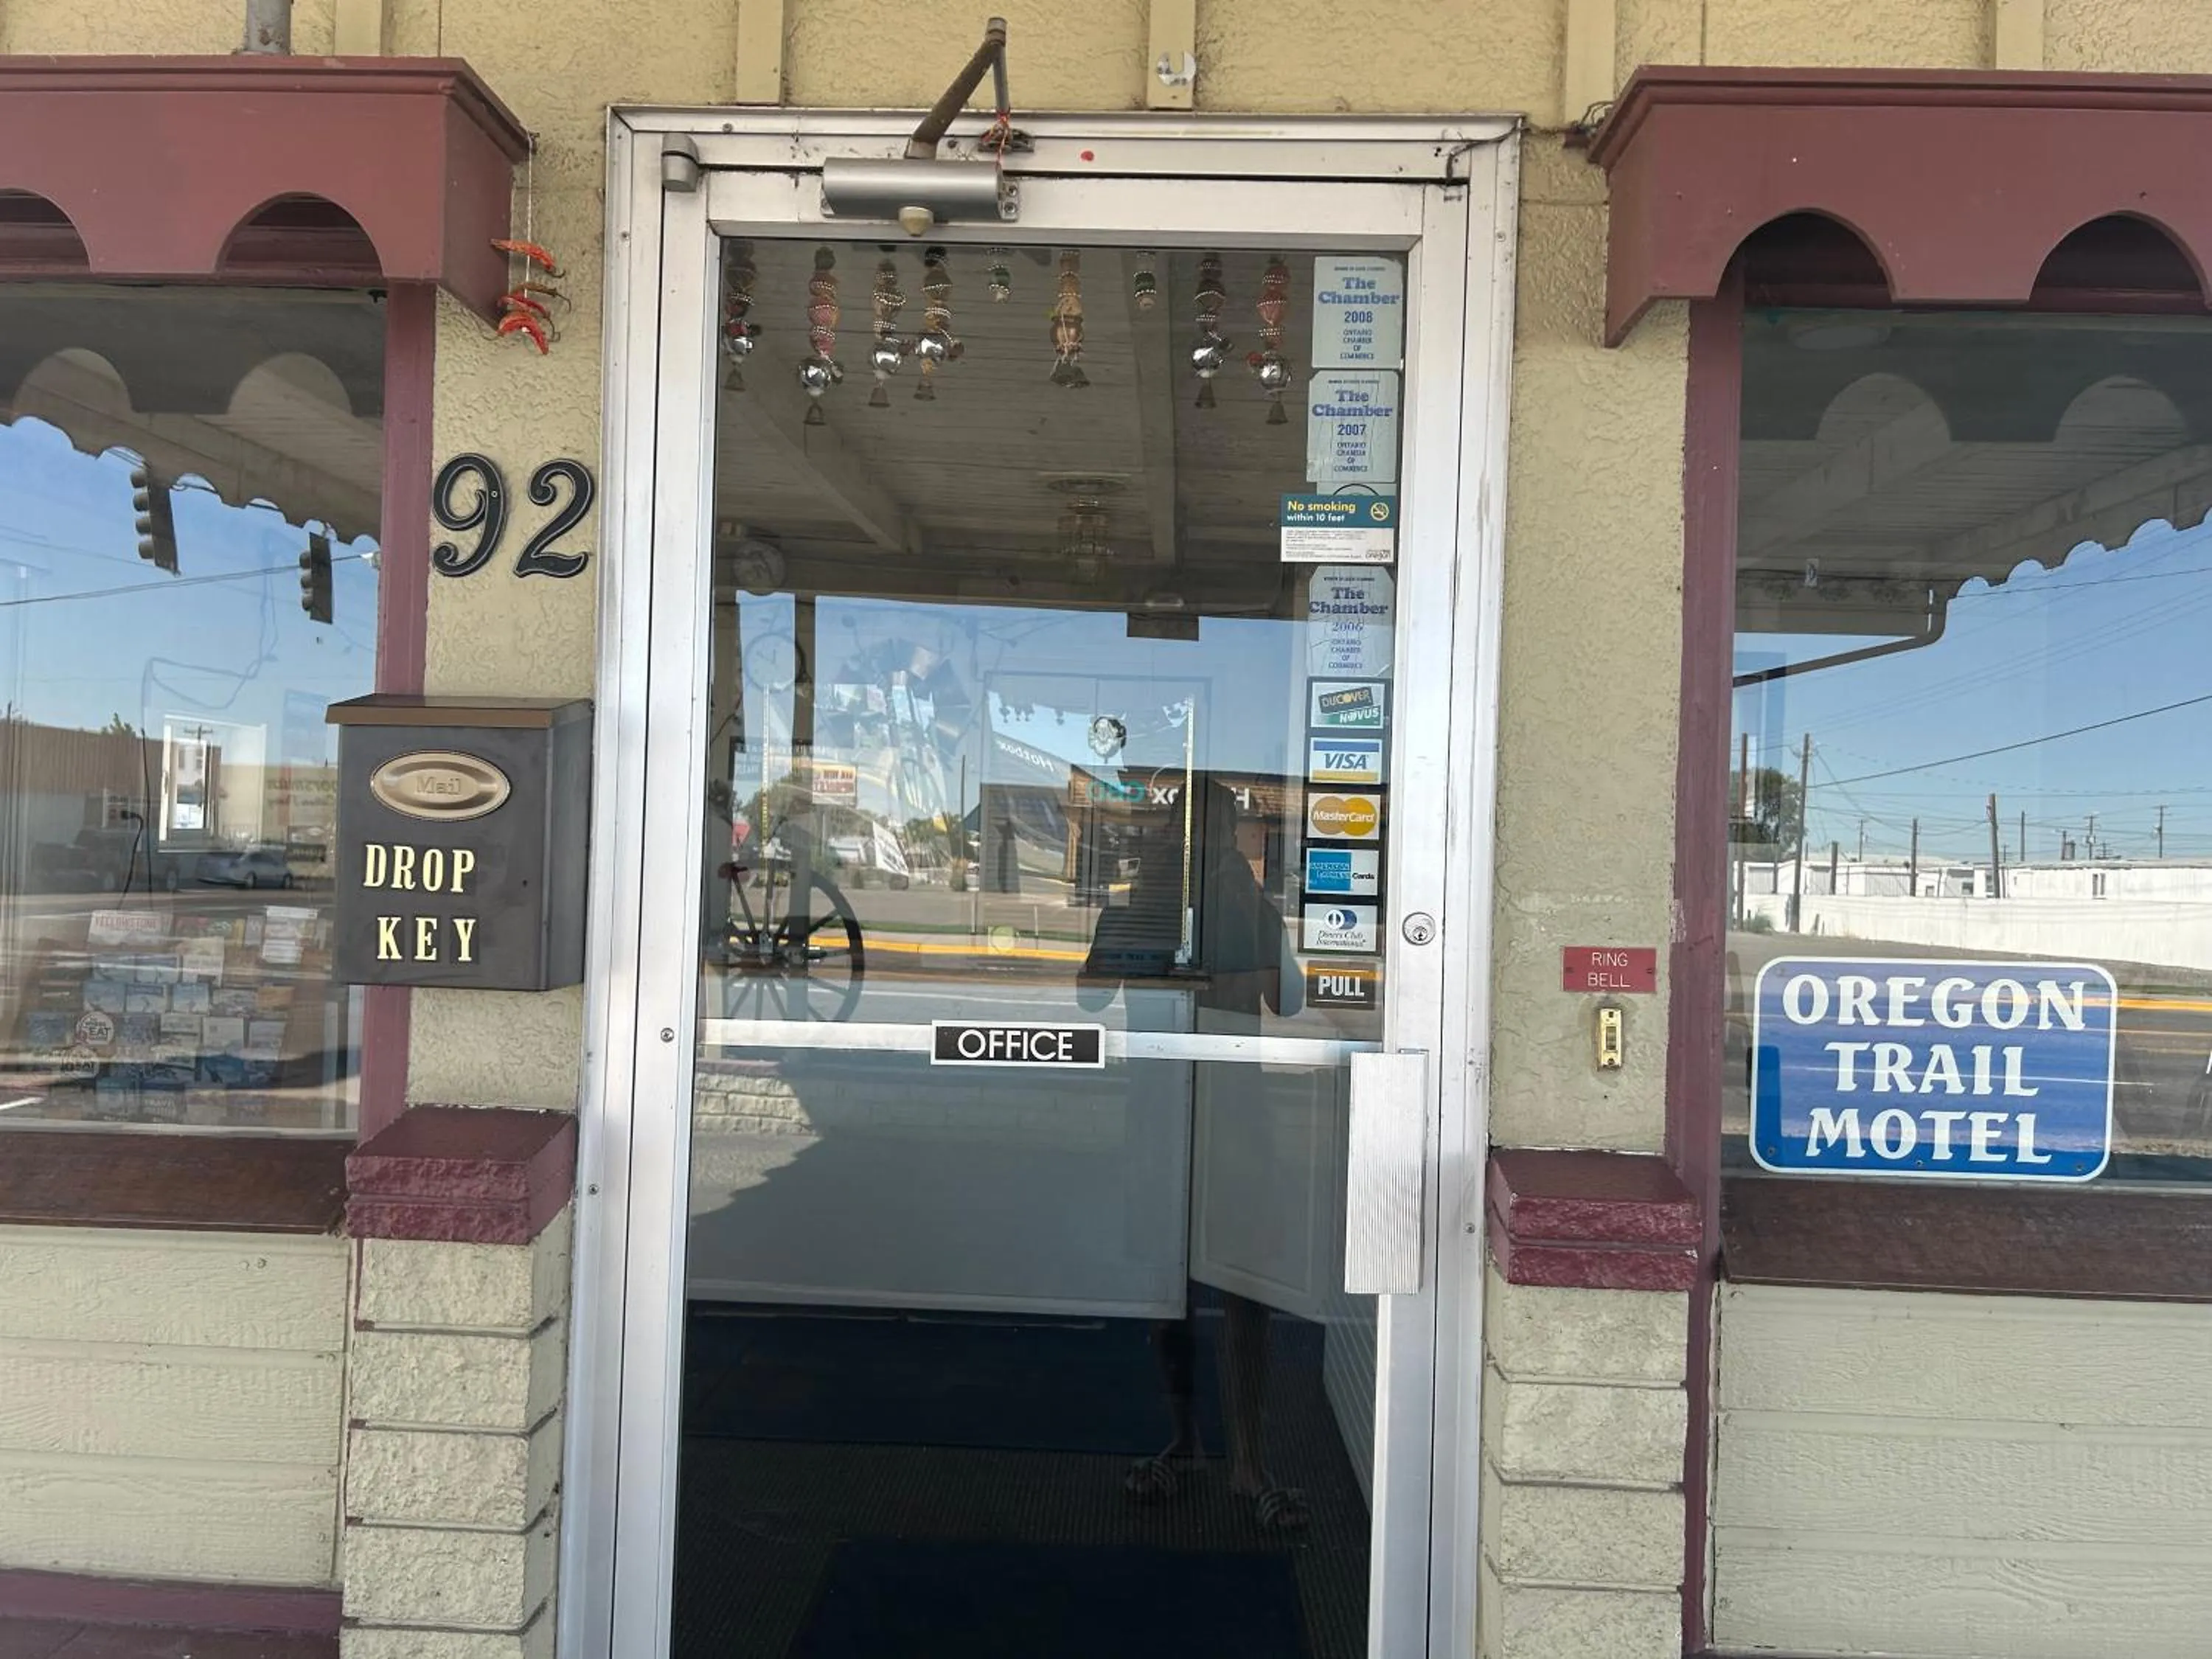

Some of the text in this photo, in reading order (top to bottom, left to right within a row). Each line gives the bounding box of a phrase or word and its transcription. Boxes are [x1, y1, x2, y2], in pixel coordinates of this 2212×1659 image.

[1343, 277, 1376, 290] The
[1318, 291, 1400, 305] Chamber
[1344, 310, 1374, 323] 2008
[1335, 390, 1369, 402] The
[1312, 404, 1393, 417] Chamber
[1337, 424, 1366, 436] 2007
[1287, 501, 1357, 514] No smoking
[432, 452, 594, 579] 92
[1330, 587, 1365, 599] The
[1310, 601, 1388, 614] Chamber
[1332, 622, 1364, 632] 2006
[1321, 689, 1371, 708] DISCOVER
[1339, 707, 1380, 723] NOVUS
[1324, 754, 1368, 769] VISA
[417, 776, 462, 795] Mail
[1313, 811, 1375, 822] MasterCard
[363, 844, 476, 893] DROP
[377, 916, 476, 961] KEY
[1591, 952, 1628, 967] RING
[1318, 975, 1365, 997] PULL
[1587, 972, 1631, 987] BELL
[1782, 974, 2086, 1030] OREGON
[957, 1029, 1073, 1060] OFFICE
[1824, 1042, 2039, 1096] TRAIL
[1805, 1107, 2053, 1164] MOTEL
